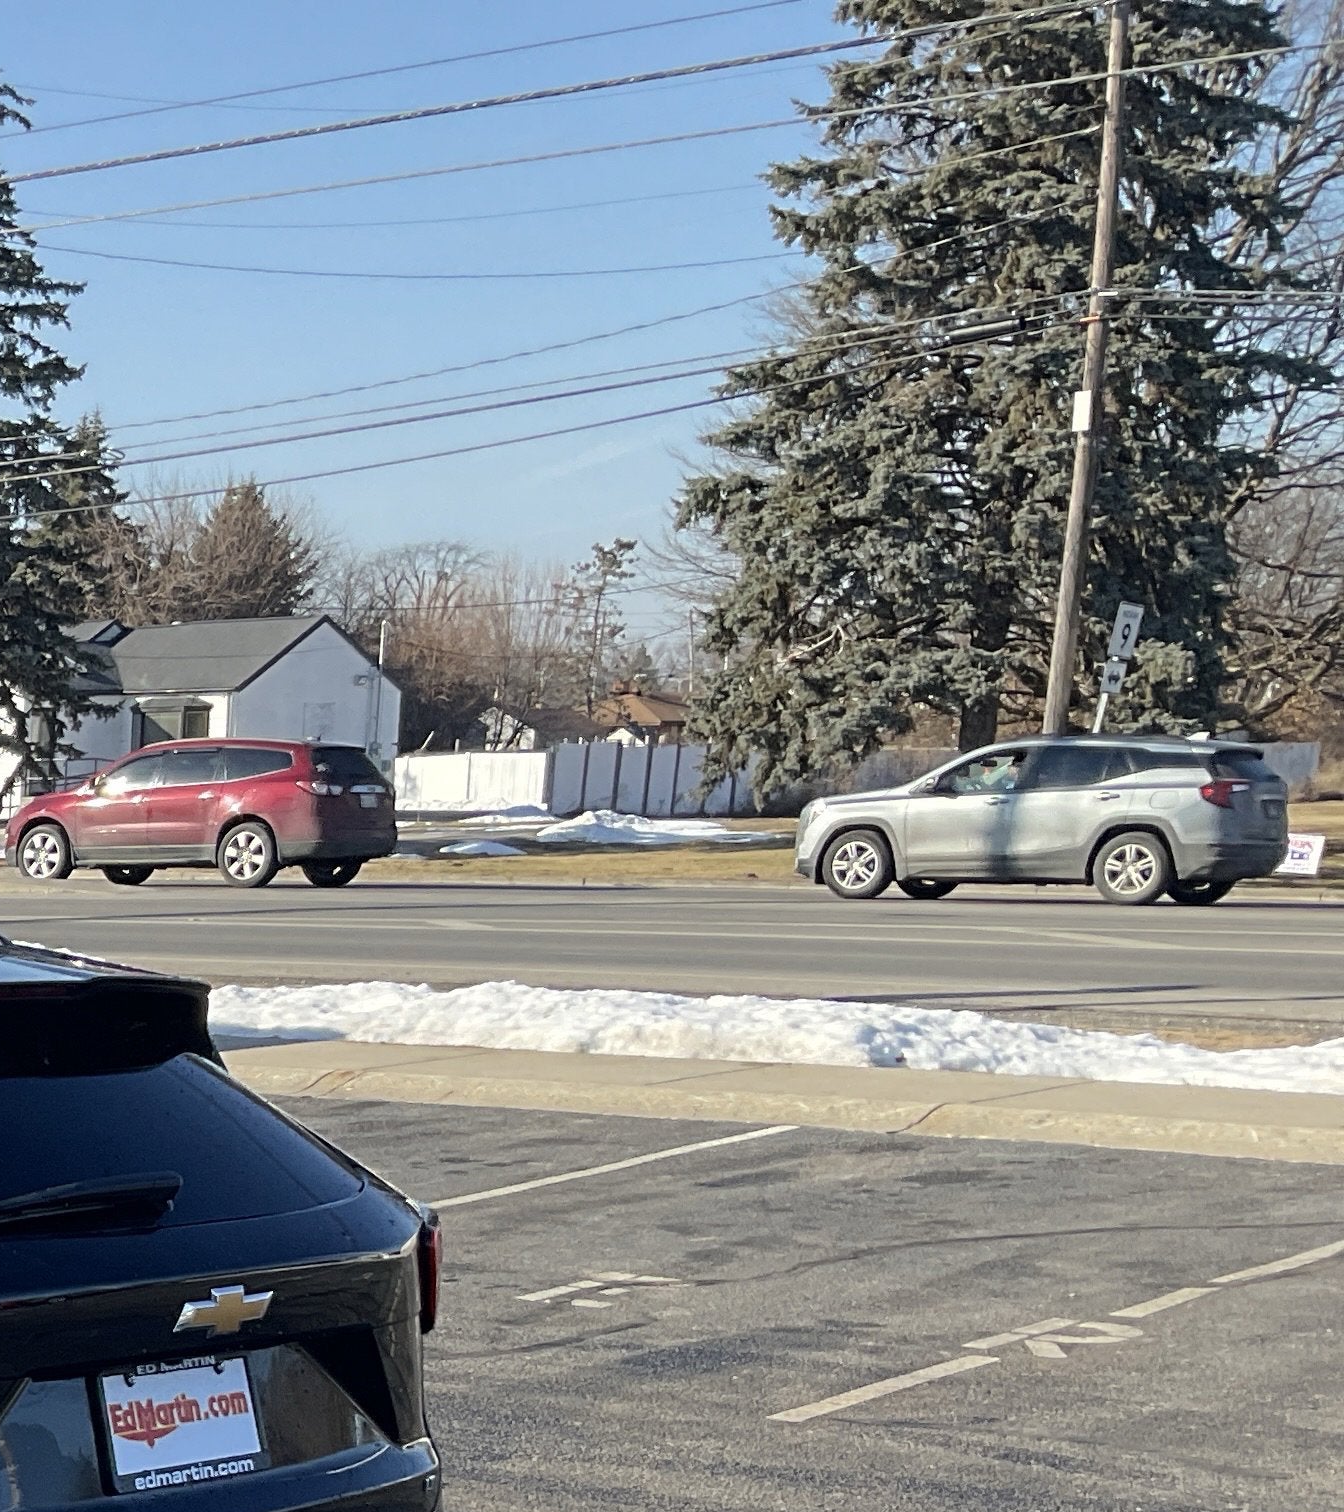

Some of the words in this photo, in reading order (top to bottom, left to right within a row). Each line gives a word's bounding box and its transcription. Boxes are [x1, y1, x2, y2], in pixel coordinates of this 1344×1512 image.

[136, 1364, 157, 1376] ED
[160, 1354, 216, 1373] MARTIN
[108, 1391, 249, 1434] EdMartin.com
[134, 1458, 255, 1491] edmartin.com
